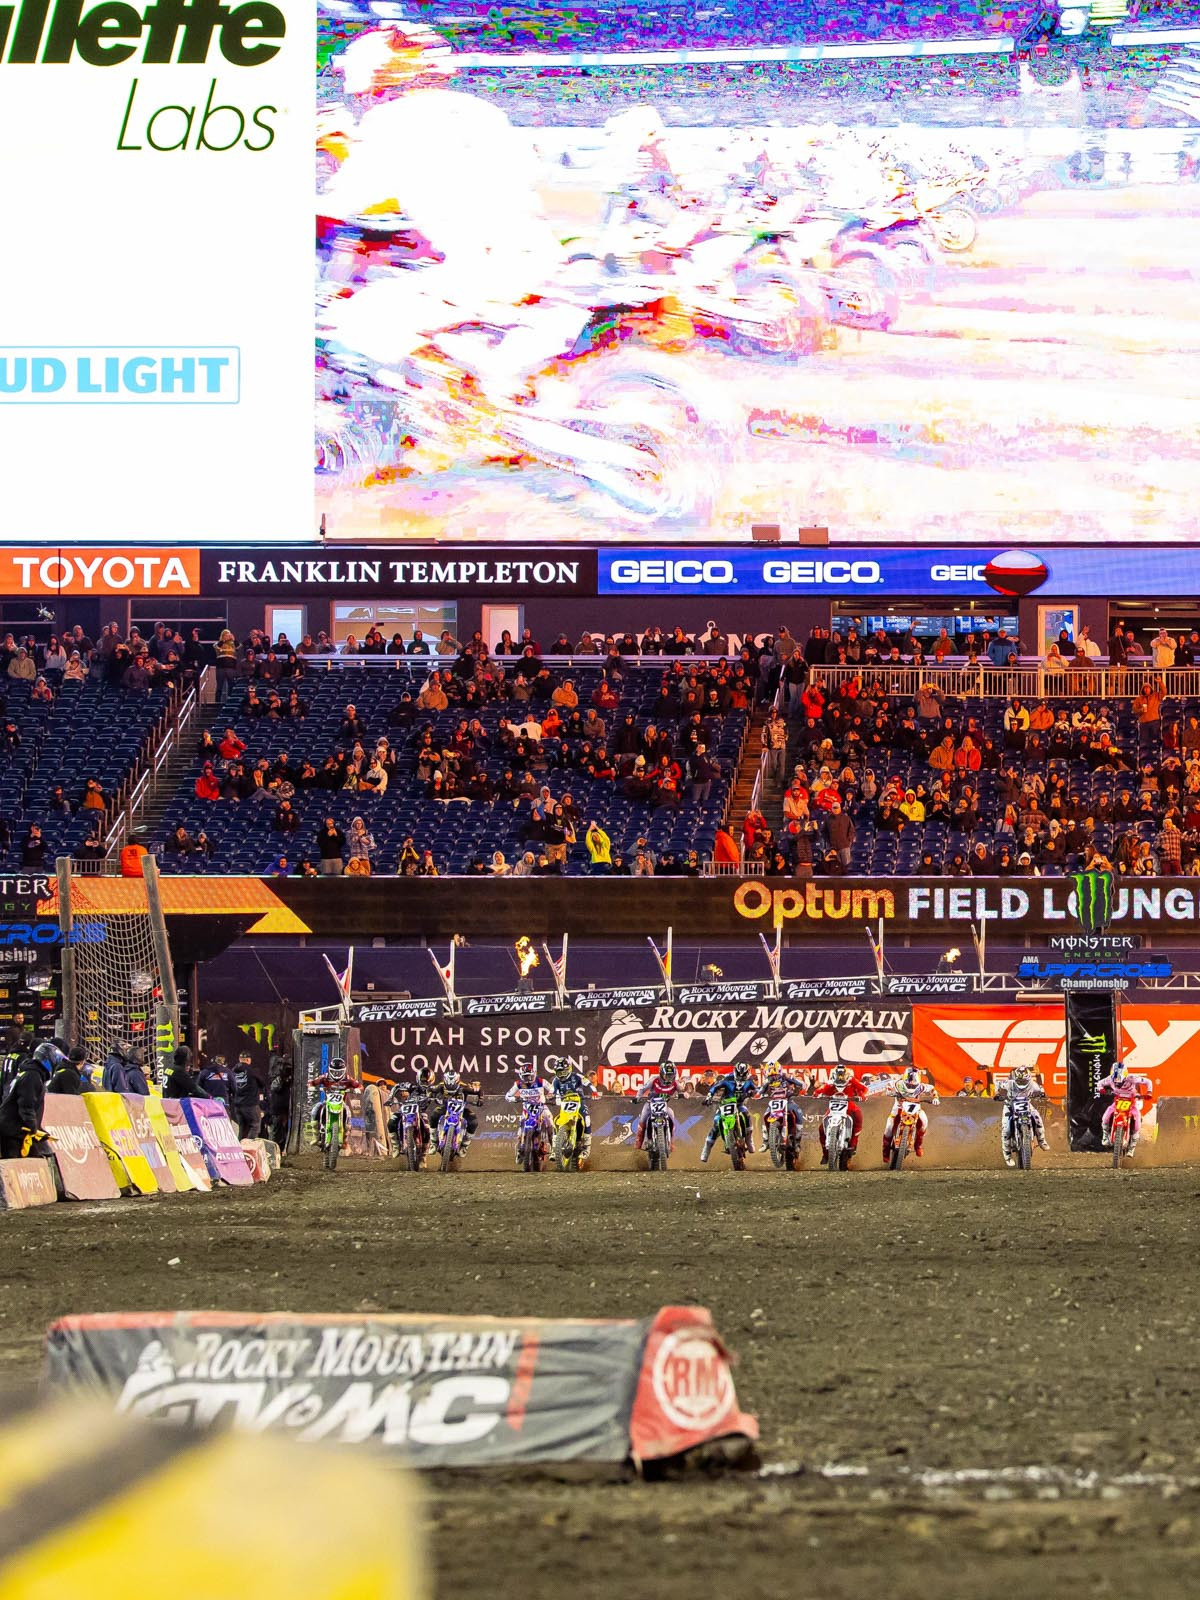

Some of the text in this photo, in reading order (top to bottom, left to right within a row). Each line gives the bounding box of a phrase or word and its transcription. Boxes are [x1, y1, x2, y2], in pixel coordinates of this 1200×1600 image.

[0, 0, 286, 66] llette
[116, 78, 277, 151] Labs
[77, 358, 229, 394] LIGHT
[13, 556, 191, 589] TOYOTA
[218, 561, 579, 583] FRANKLIN TEMPLETON
[610, 560, 733, 584] GEICO
[763, 560, 880, 584] GEICO
[931, 564, 988, 582] GEIC
[734, 881, 894, 928] Optum
[908, 887, 1028, 919] FIELD
[1051, 935, 1133, 950] MONSTER
[1016, 963, 1173, 977] SUPERCROSS
[800, 981, 823, 989] ROCKY
[1060, 978, 1129, 989] Championship
[396, 1001, 437, 1010] MOUNTAIN
[480, 996, 503, 1004] ROCKY
[649, 1005, 909, 1030] ROCKY MOUNTAIN
[390, 1027, 587, 1046] UTAH SPORTS
[390, 1054, 584, 1074] COMMISSION
[328, 1094, 343, 1102] 29
[402, 1105, 418, 1113] 91
[528, 1103, 542, 1113] 45
[563, 1101, 577, 1111] 12
[652, 1102, 666, 1112] 32
[723, 1105, 735, 1115] 9
[771, 1101, 786, 1109] 51
[831, 1103, 846, 1112] 27
[907, 1104, 915, 1113] 1
[1015, 1101, 1028, 1111] 3
[1116, 1100, 1131, 1110] 18
[486, 1114, 523, 1124] MONST
[178, 1327, 522, 1380] ROCKY MOUNTAIN
[669, 1349, 724, 1403] RM
